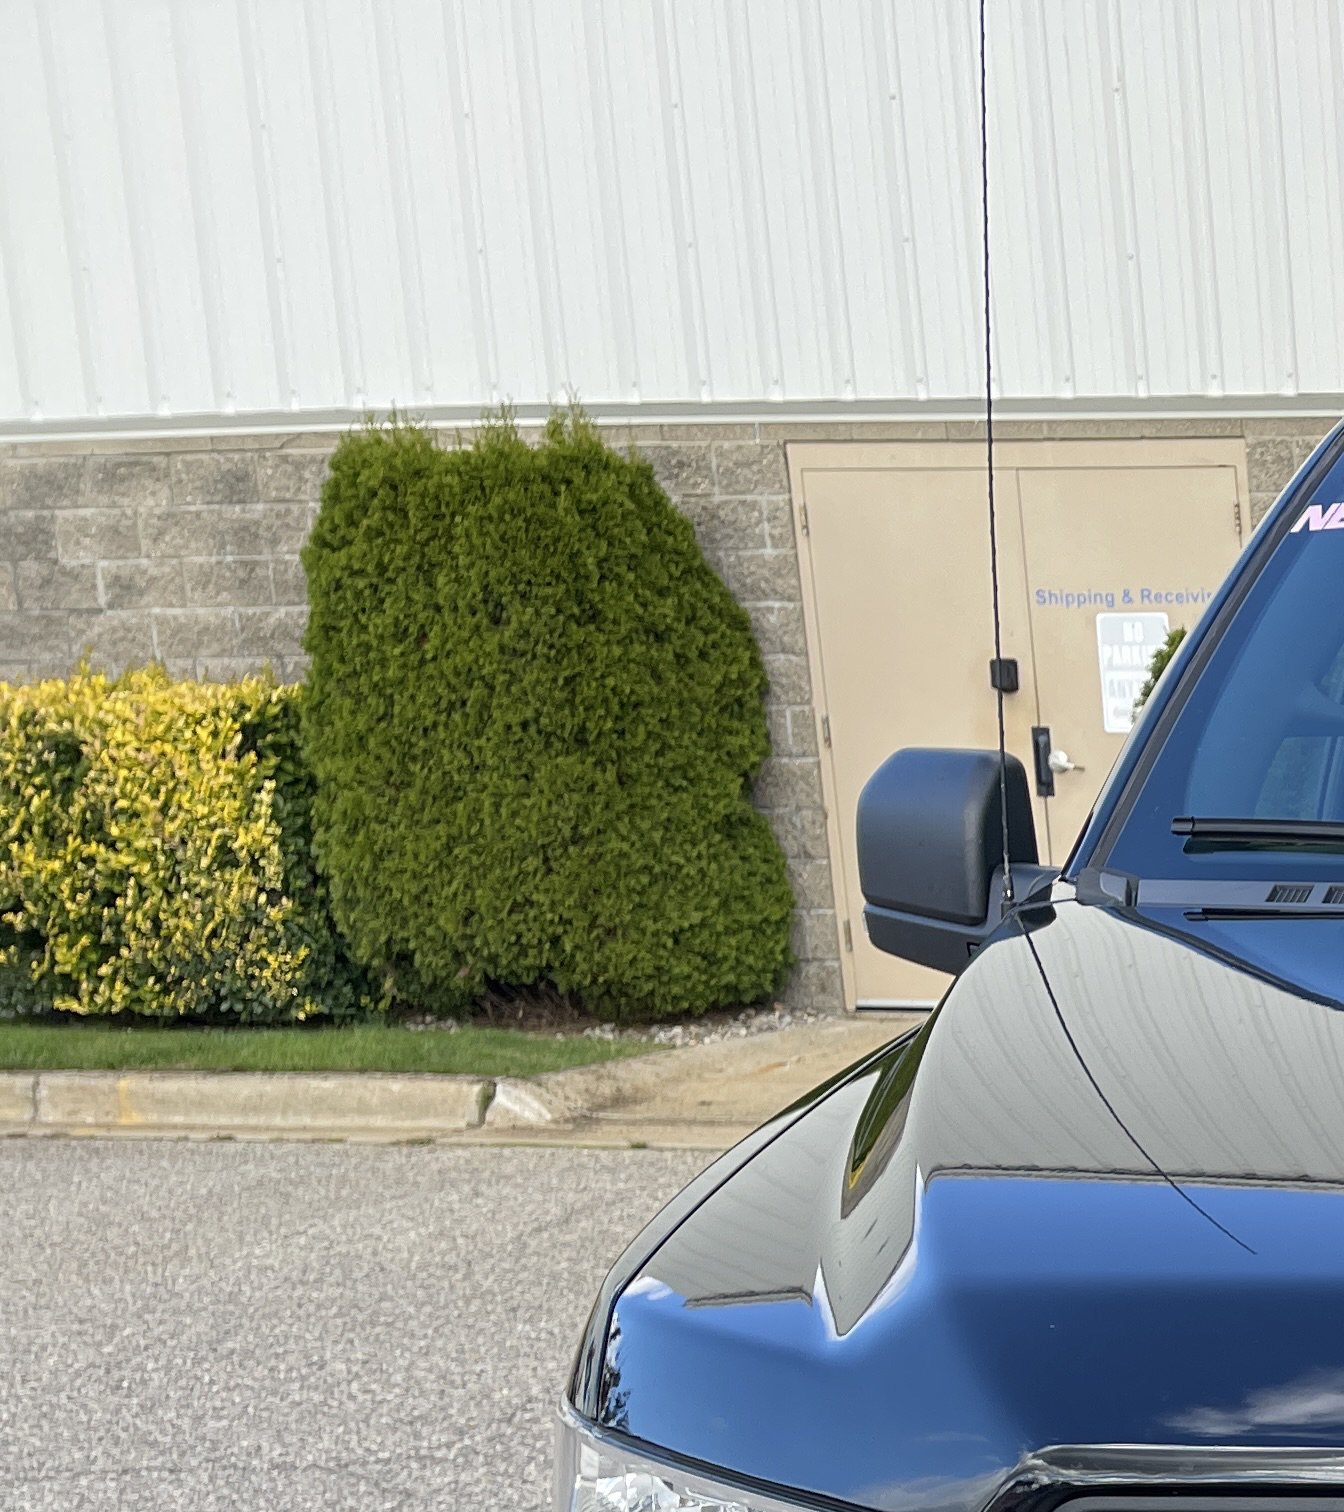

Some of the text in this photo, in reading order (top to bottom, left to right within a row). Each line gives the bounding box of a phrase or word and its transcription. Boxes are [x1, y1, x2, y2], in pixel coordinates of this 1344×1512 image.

[1034, 586, 1212, 608] Shipping & Receivi
[1122, 620, 1145, 643] NO
